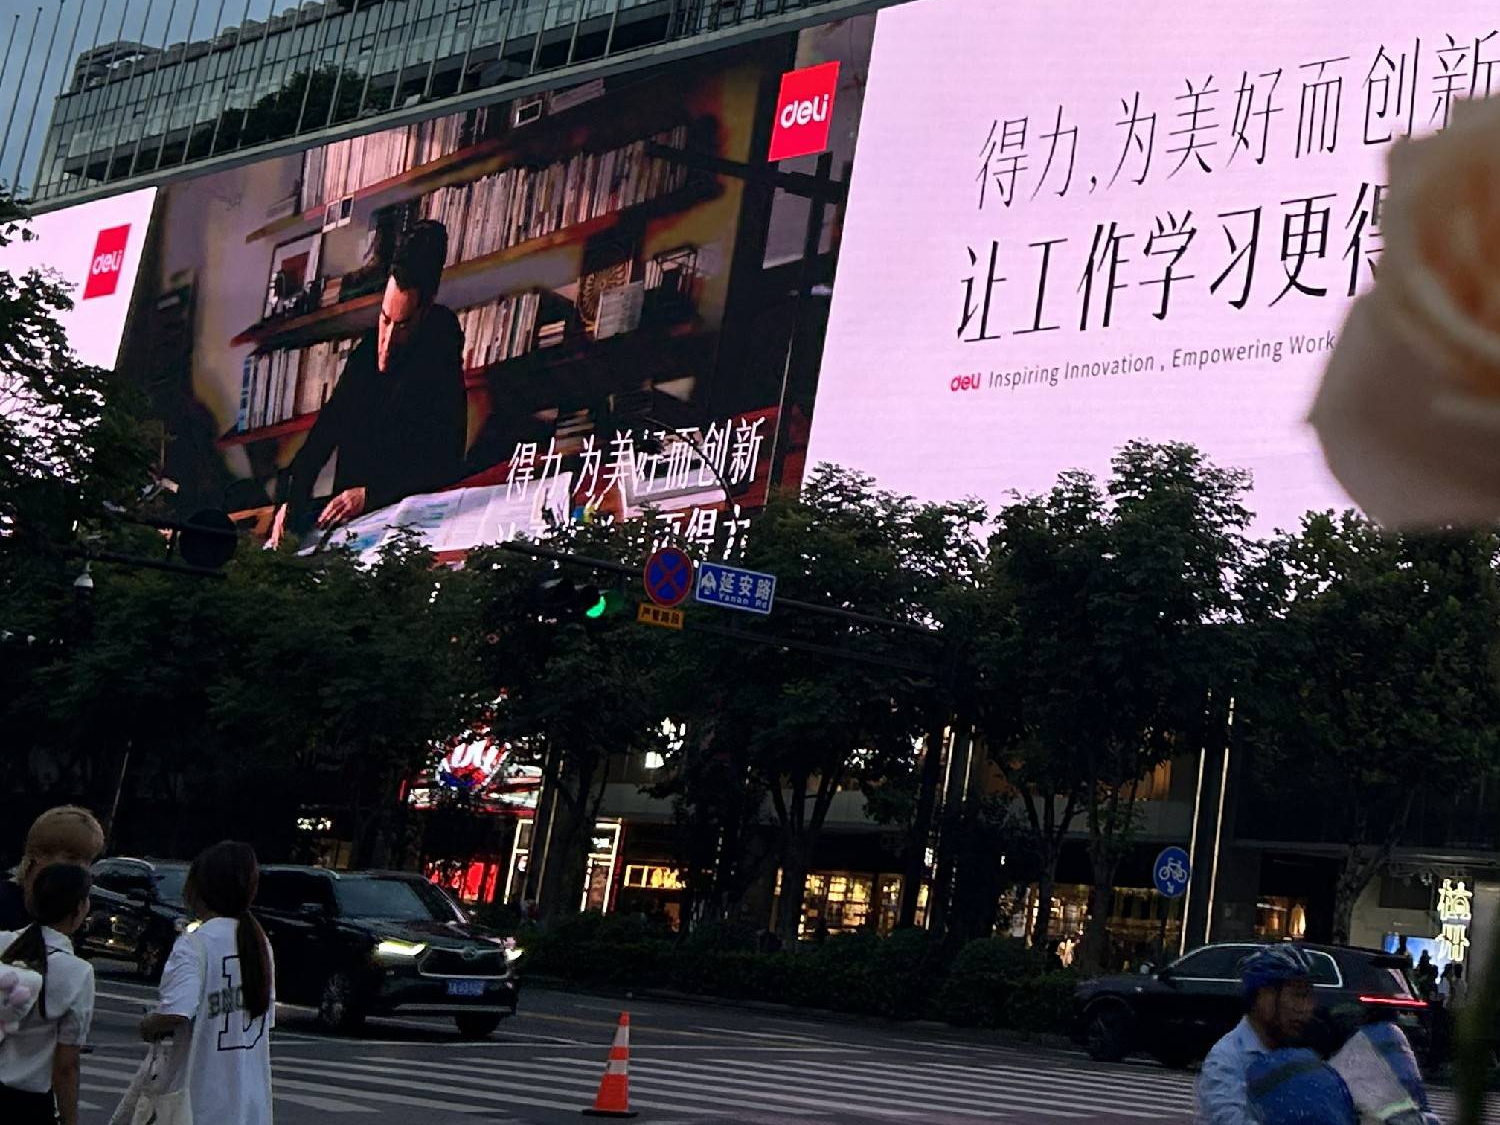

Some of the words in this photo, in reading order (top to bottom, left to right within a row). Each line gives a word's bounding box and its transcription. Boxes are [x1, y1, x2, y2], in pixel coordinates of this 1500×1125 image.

[780, 93, 829, 129] deli
[92, 249, 123, 276] deli
[988, 366, 1060, 391] Inspiring
[1064, 355, 1155, 380] Innovation
[1172, 339, 1284, 371] Empowering
[718, 570, 773, 600] 延安路
[755, 596, 767, 610] Rd
